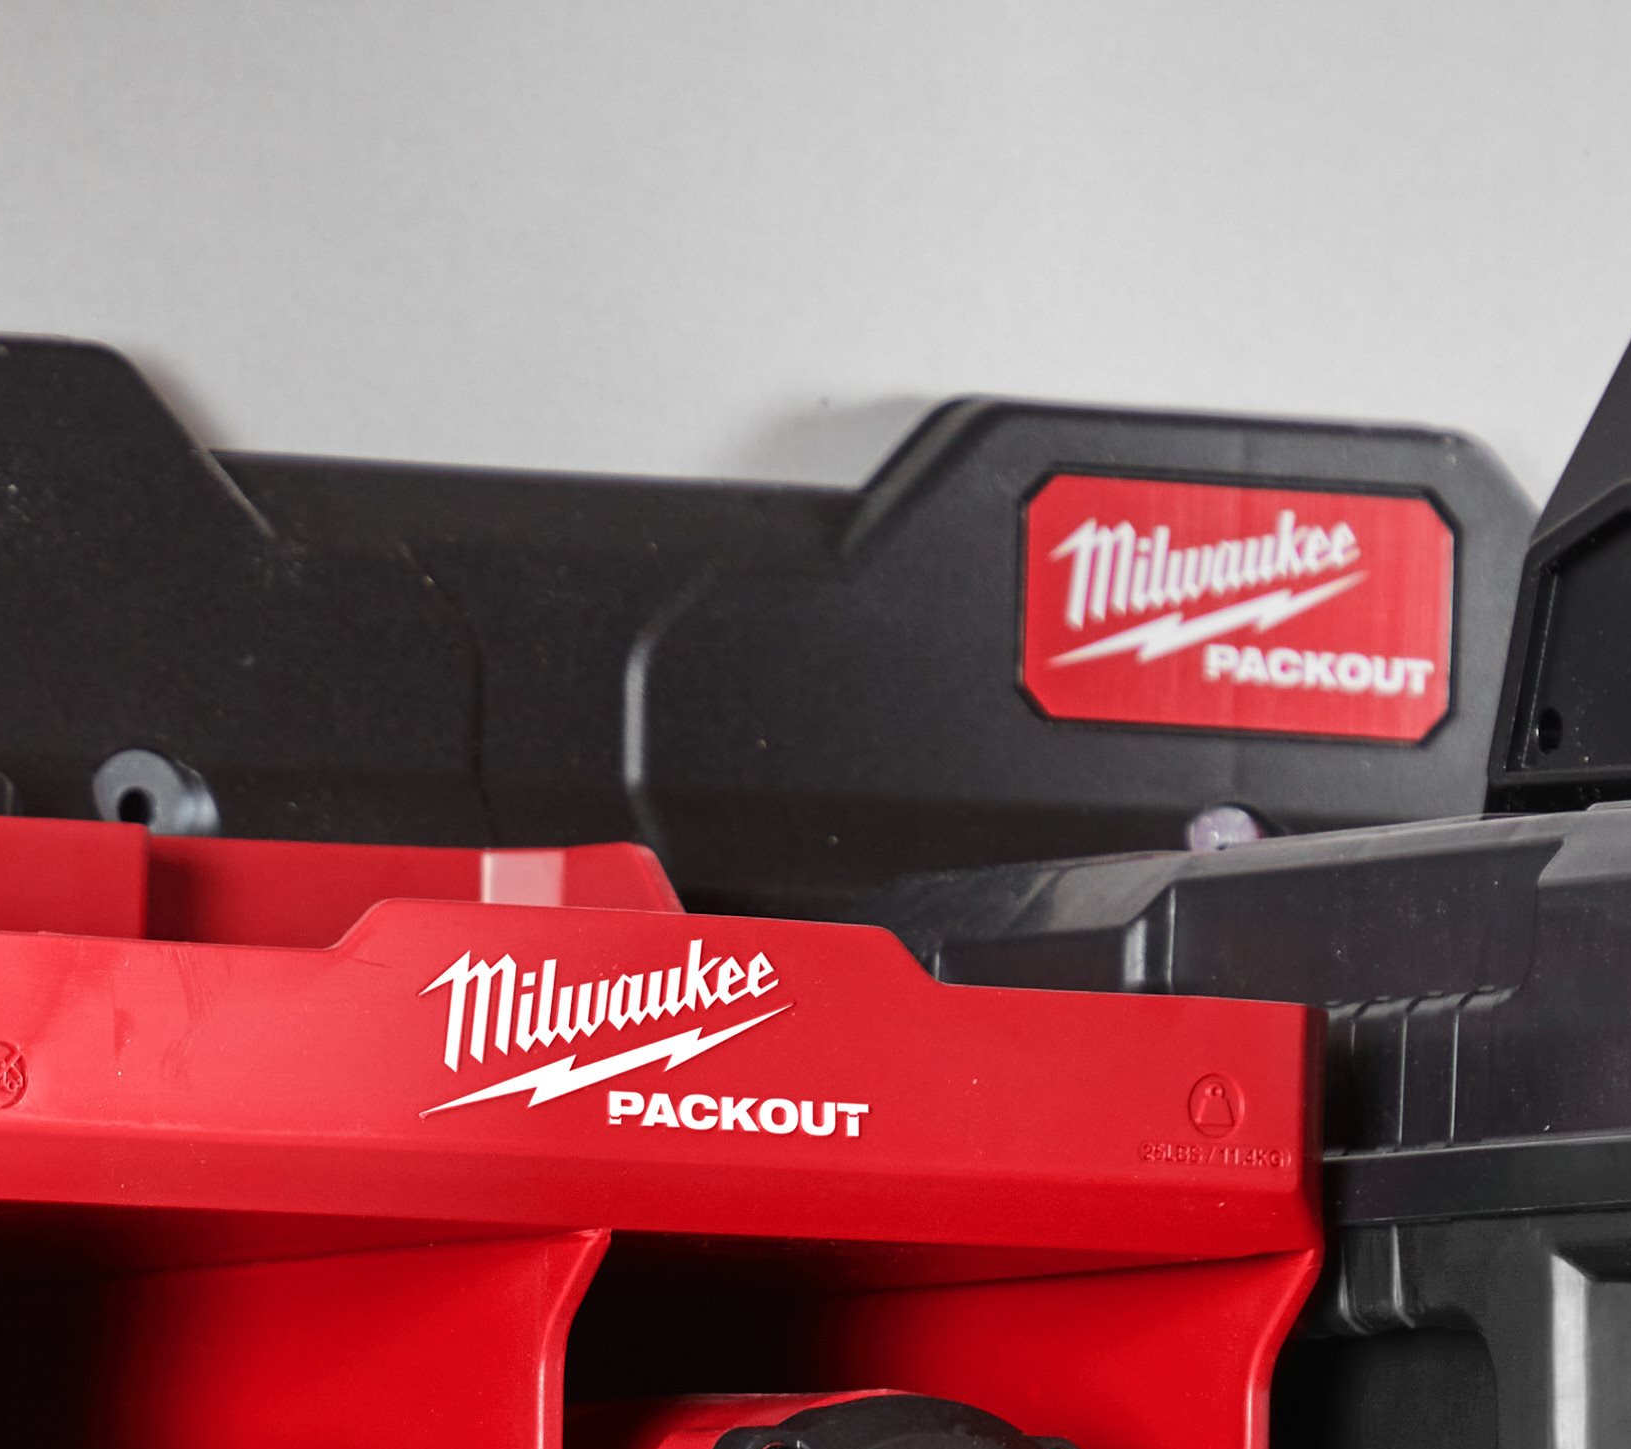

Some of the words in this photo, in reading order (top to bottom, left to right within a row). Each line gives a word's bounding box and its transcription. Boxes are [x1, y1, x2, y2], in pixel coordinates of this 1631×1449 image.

[1049, 508, 1361, 632] Milwaukee
[1203, 643, 1435, 697] PACKOUT
[418, 938, 780, 1073] Milwaukee
[607, 1089, 870, 1138] PACKOUT
[1143, 1142, 1204, 1164] 25LBS
[1220, 1147, 1285, 1169] 11.4KG
